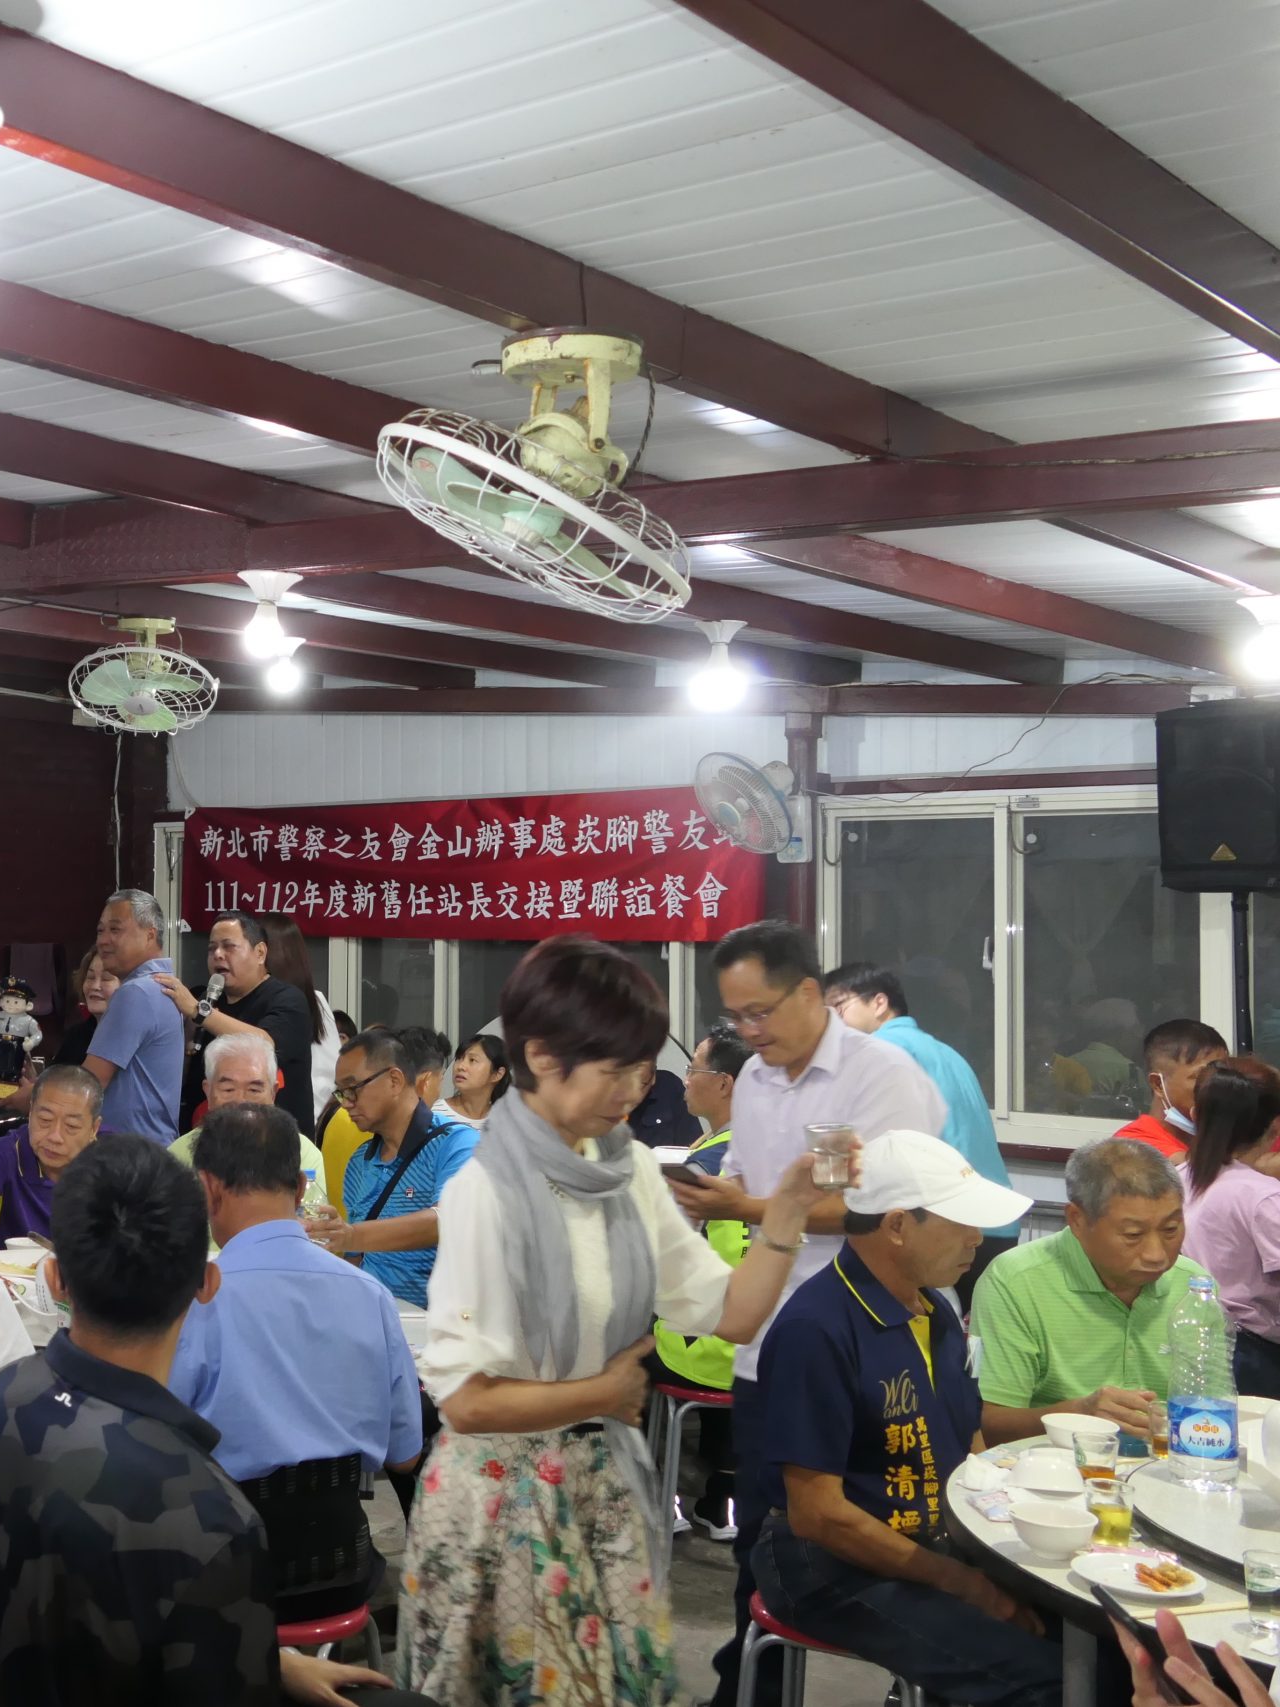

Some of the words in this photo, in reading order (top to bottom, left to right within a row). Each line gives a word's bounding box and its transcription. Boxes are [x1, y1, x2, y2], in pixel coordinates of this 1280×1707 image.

[204, 871, 729, 921] 111~112年度新舊任站長交接暨聯誼餐會
[915, 1416, 940, 1533] 萬里區崁腳里里
